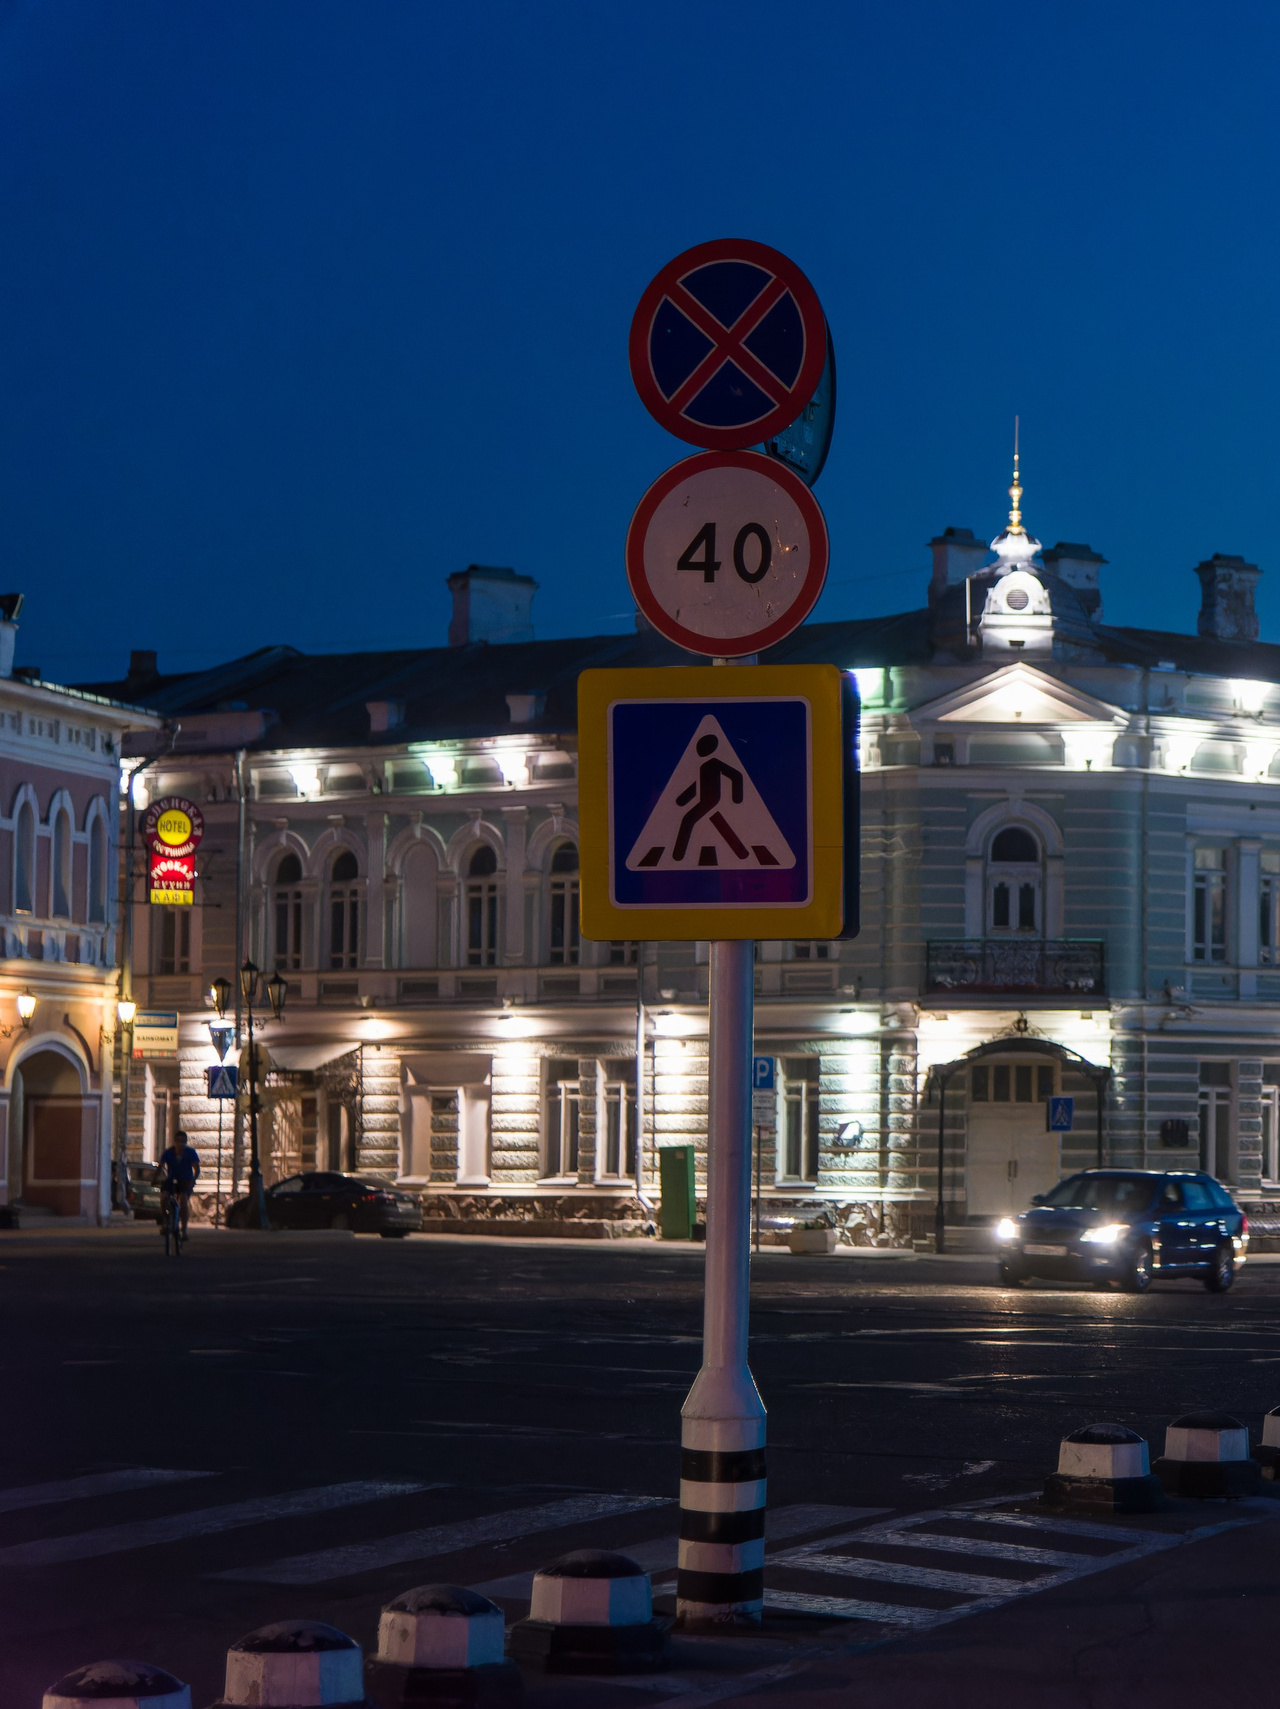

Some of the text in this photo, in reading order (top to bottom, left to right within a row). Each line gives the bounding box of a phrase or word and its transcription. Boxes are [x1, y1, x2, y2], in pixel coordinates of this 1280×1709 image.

[677, 522, 772, 584] 40
[159, 819, 188, 834] HOTEL
[154, 891, 190, 903] КАФЕ
[756, 1060, 770, 1087] P
